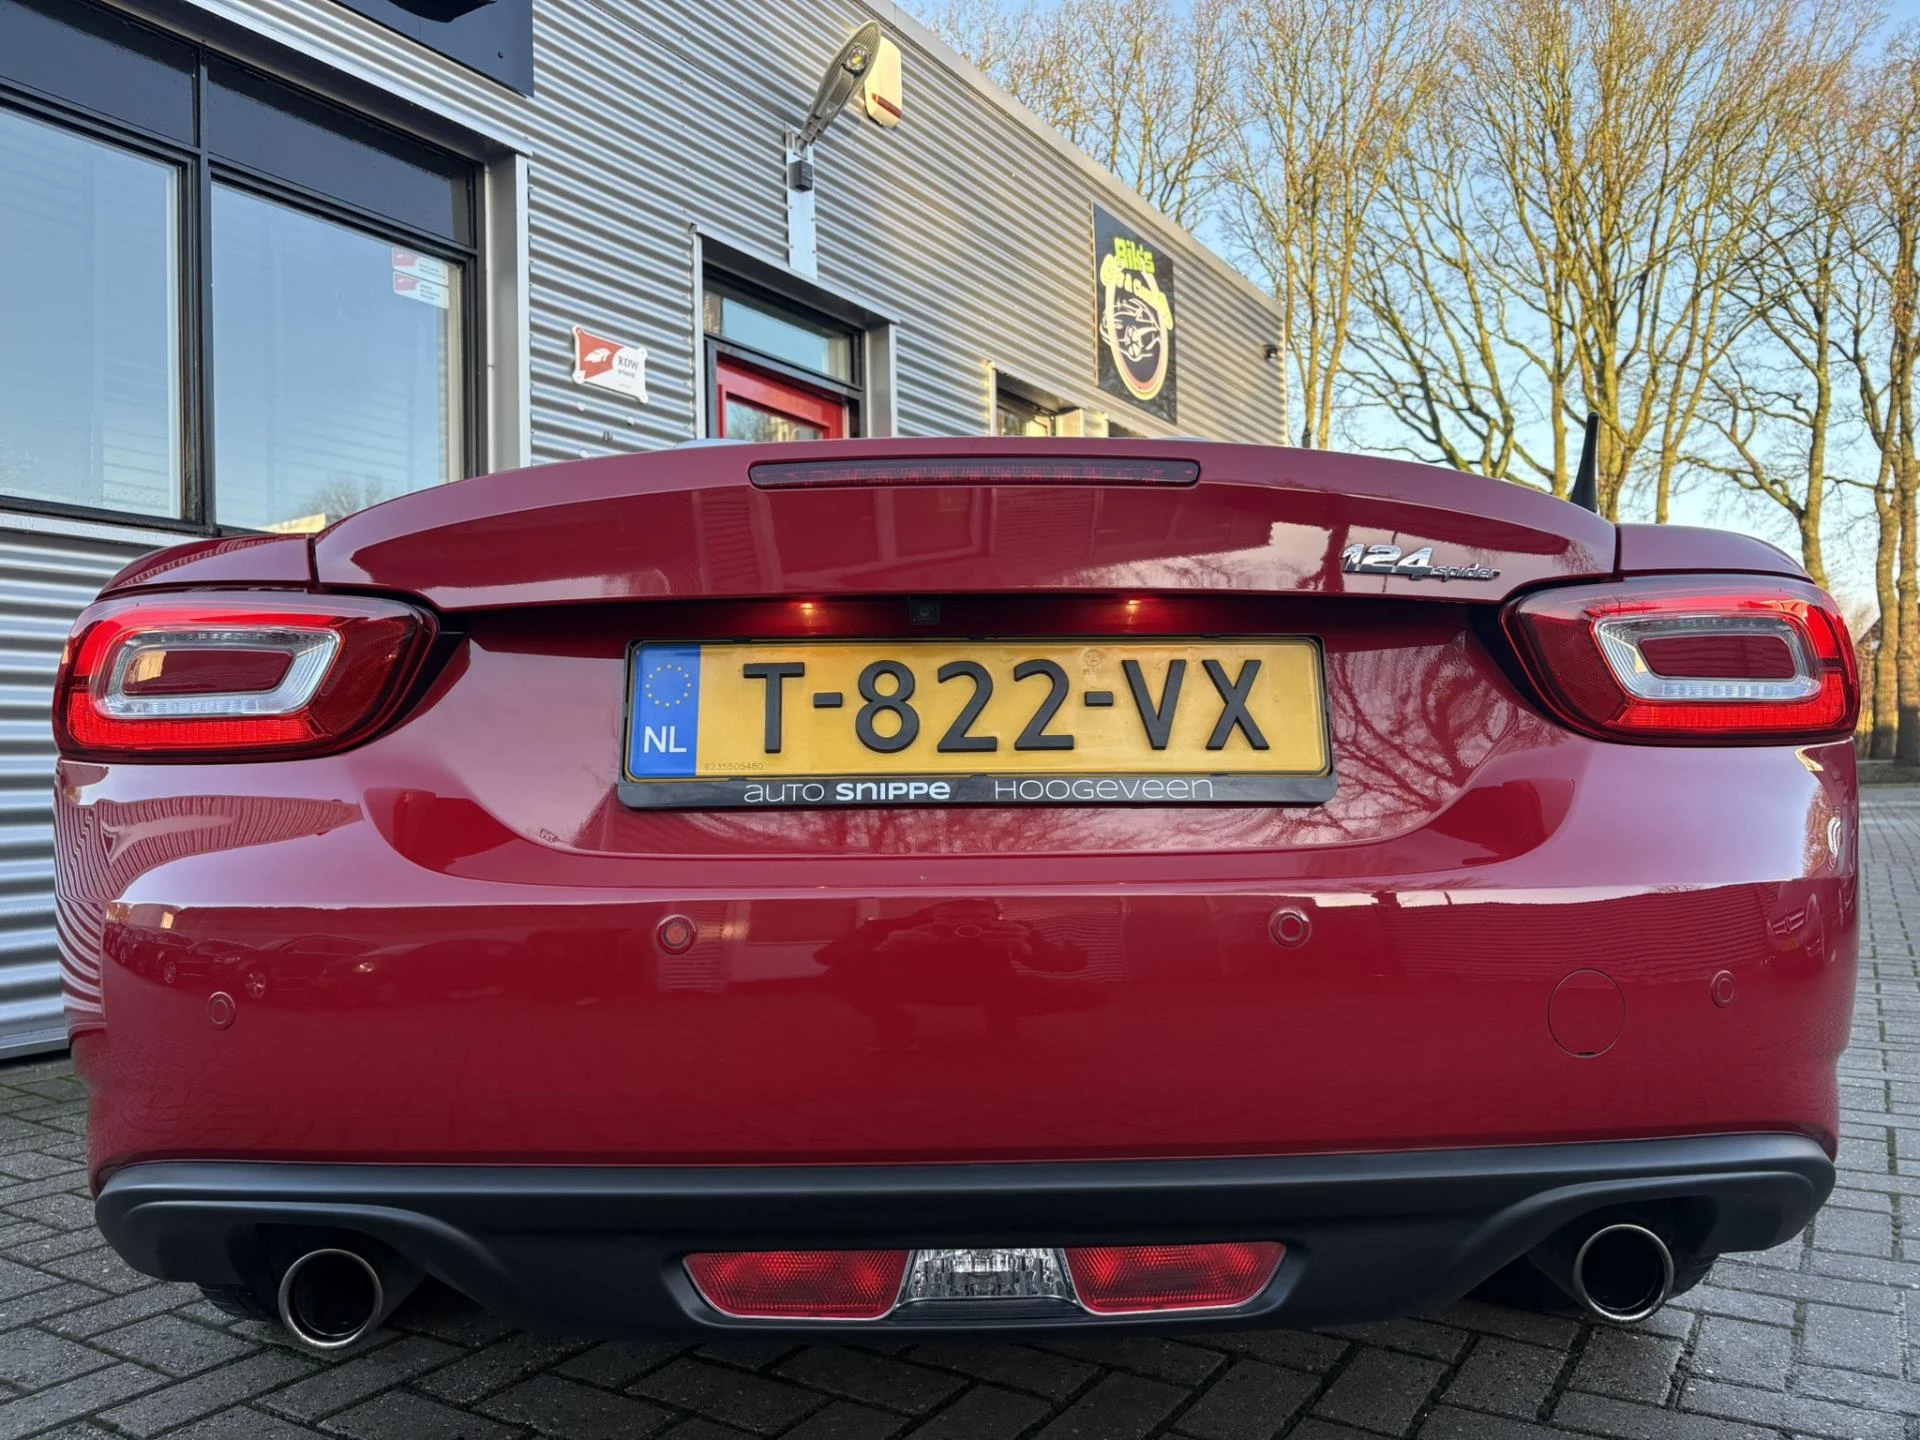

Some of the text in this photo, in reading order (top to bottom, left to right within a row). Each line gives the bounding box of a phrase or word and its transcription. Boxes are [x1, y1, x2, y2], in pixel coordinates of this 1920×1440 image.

[1340, 543, 1502, 582] 124 spider
[743, 659, 1270, 754] T-822-VX
[643, 725, 687, 754] NL
